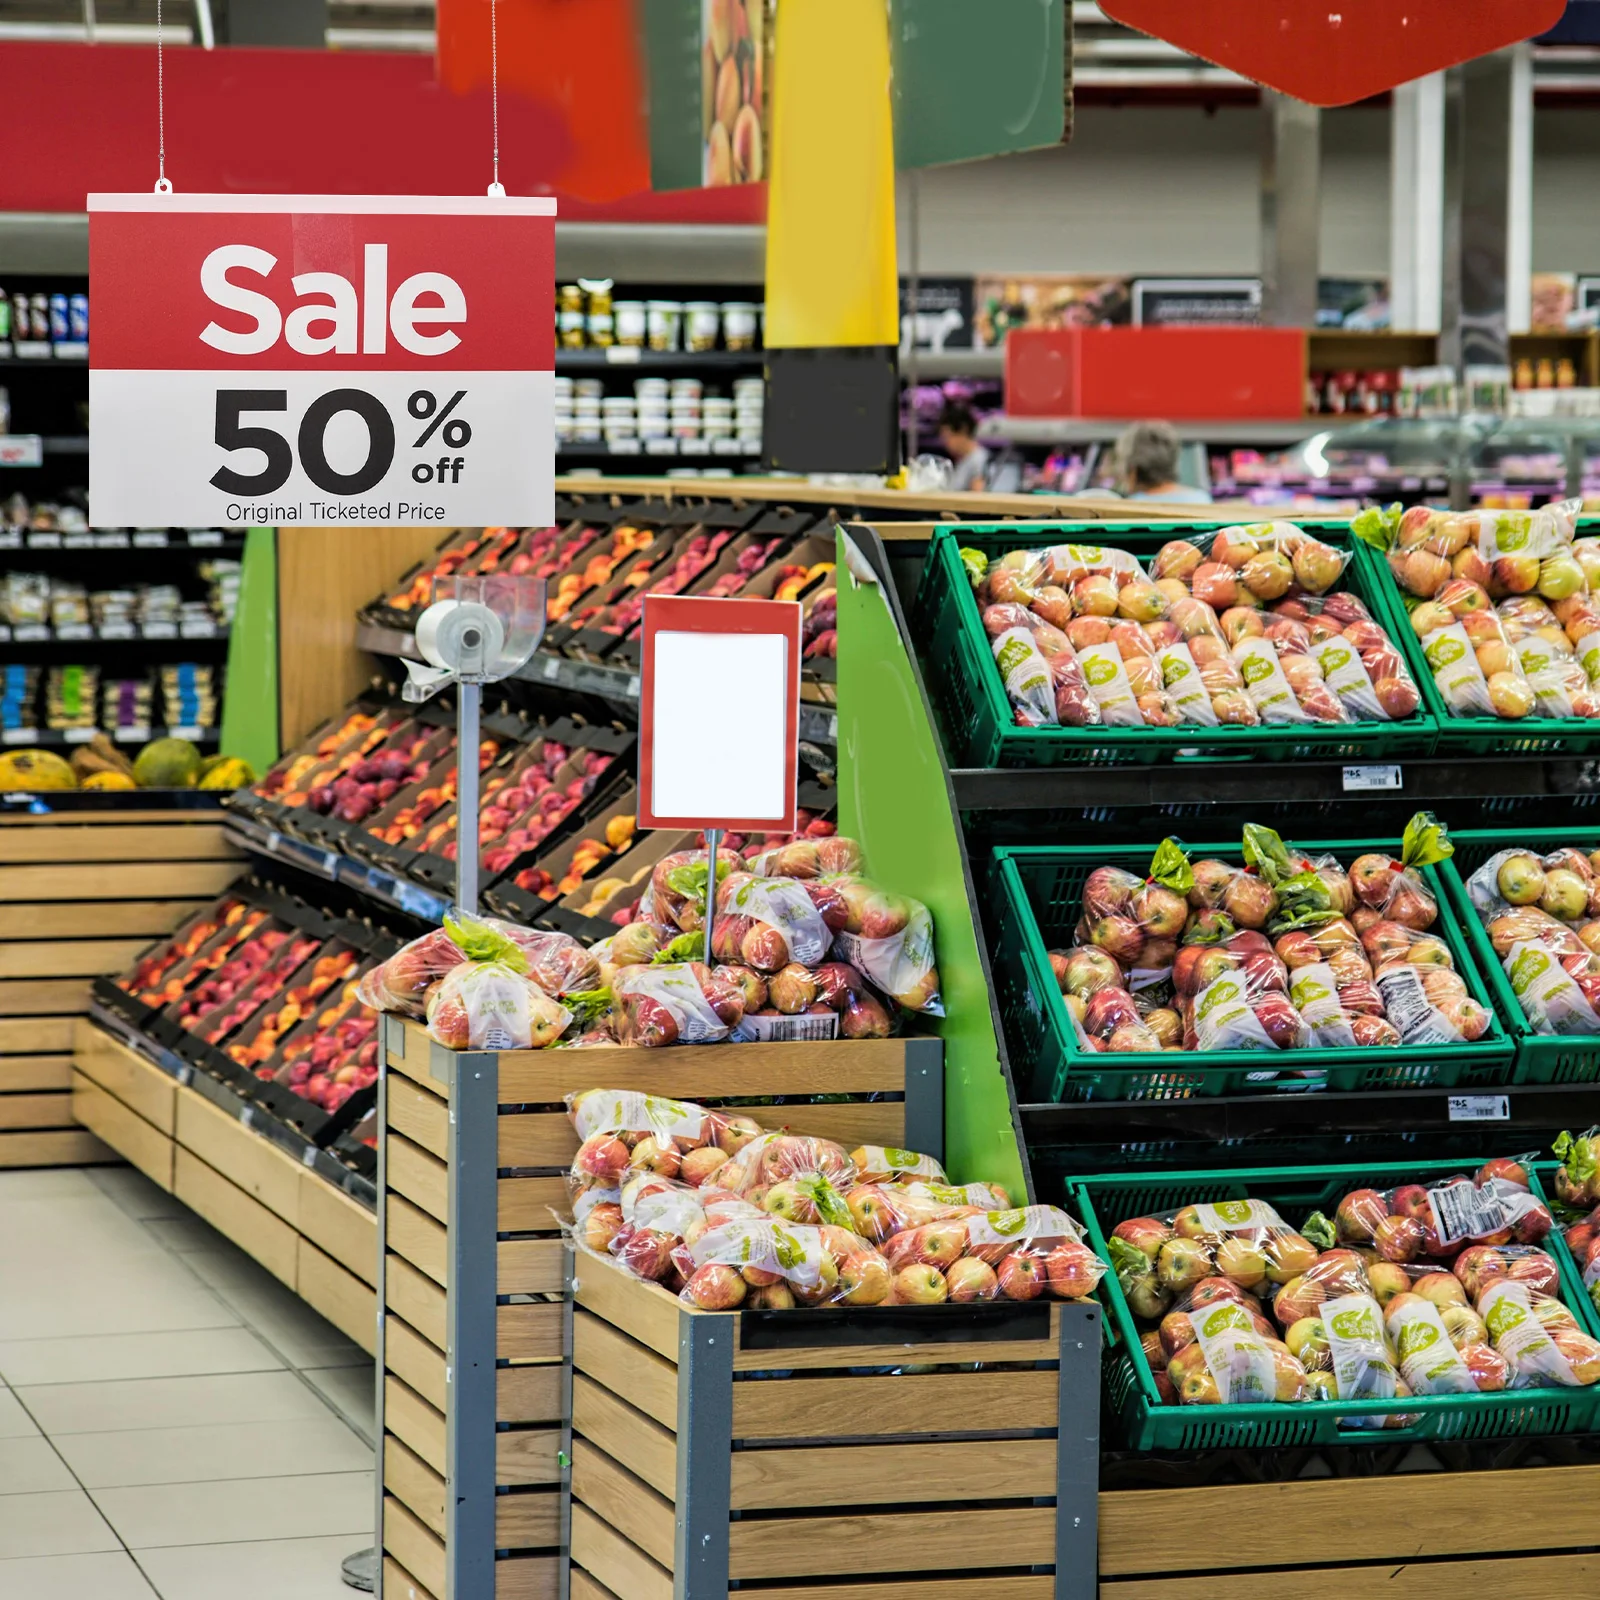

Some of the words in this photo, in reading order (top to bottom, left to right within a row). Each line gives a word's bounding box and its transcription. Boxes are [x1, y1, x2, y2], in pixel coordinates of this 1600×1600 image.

[199, 244, 467, 356] Sale
[412, 457, 465, 484] off
[227, 502, 301, 523] Original
[310, 502, 391, 520] Ticketed
[398, 502, 446, 520] Price
